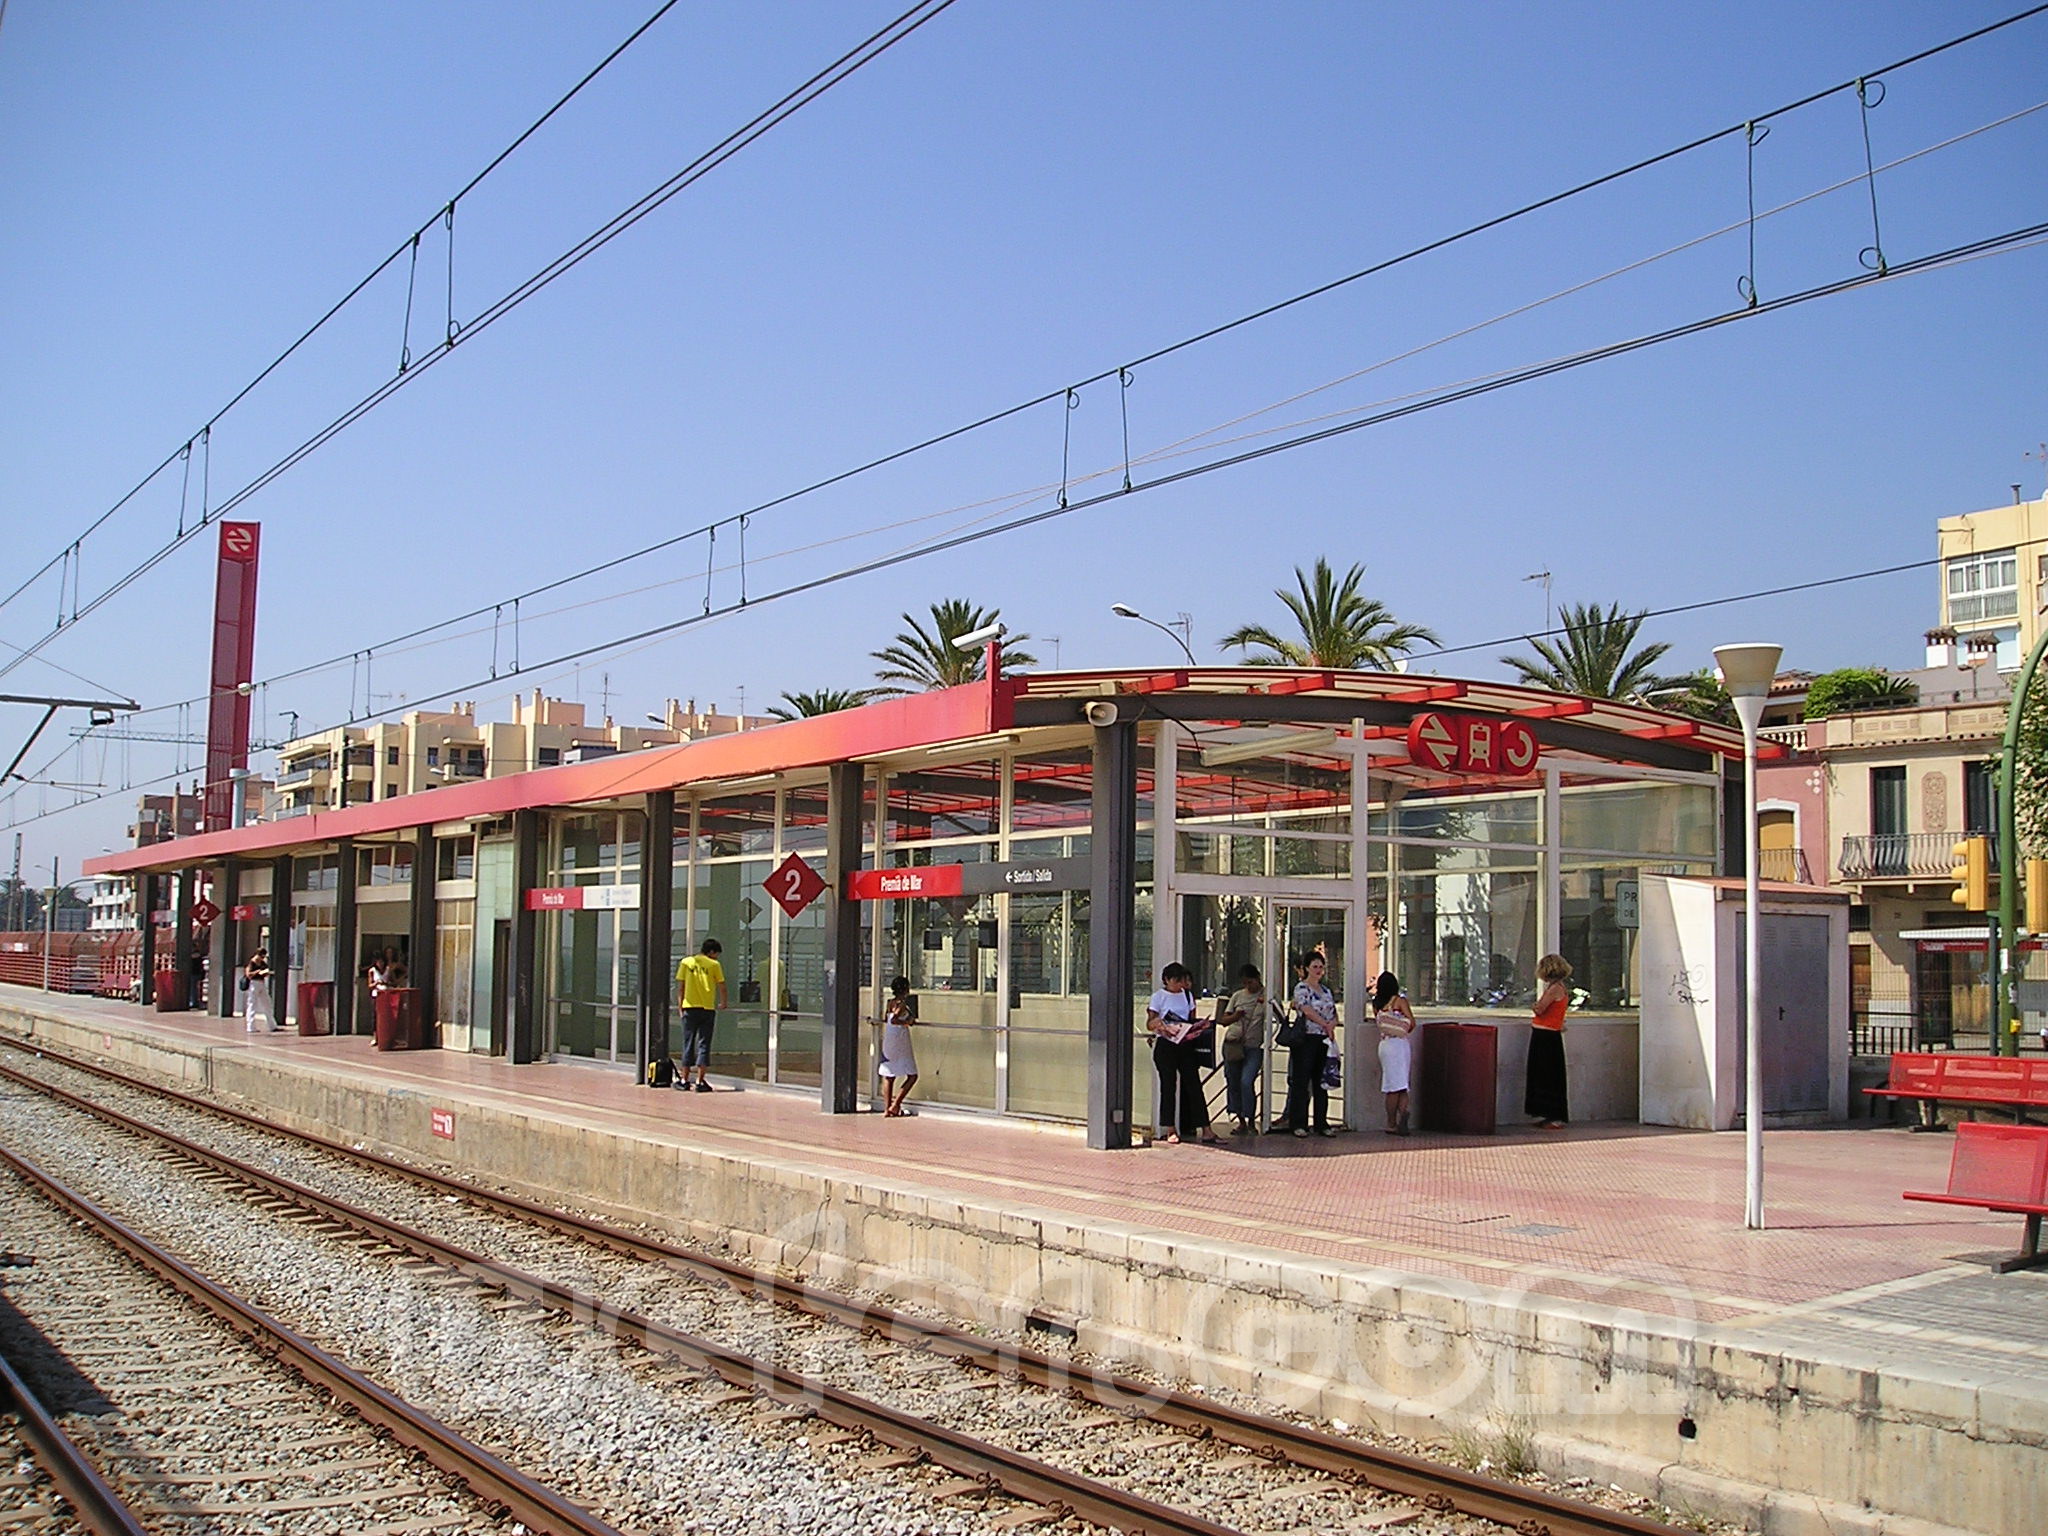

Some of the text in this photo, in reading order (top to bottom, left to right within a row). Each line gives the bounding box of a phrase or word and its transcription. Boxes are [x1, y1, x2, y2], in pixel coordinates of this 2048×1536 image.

[785, 868, 801, 901] 2
[910, 874, 923, 890] Mar
[199, 904, 209, 920] 2
